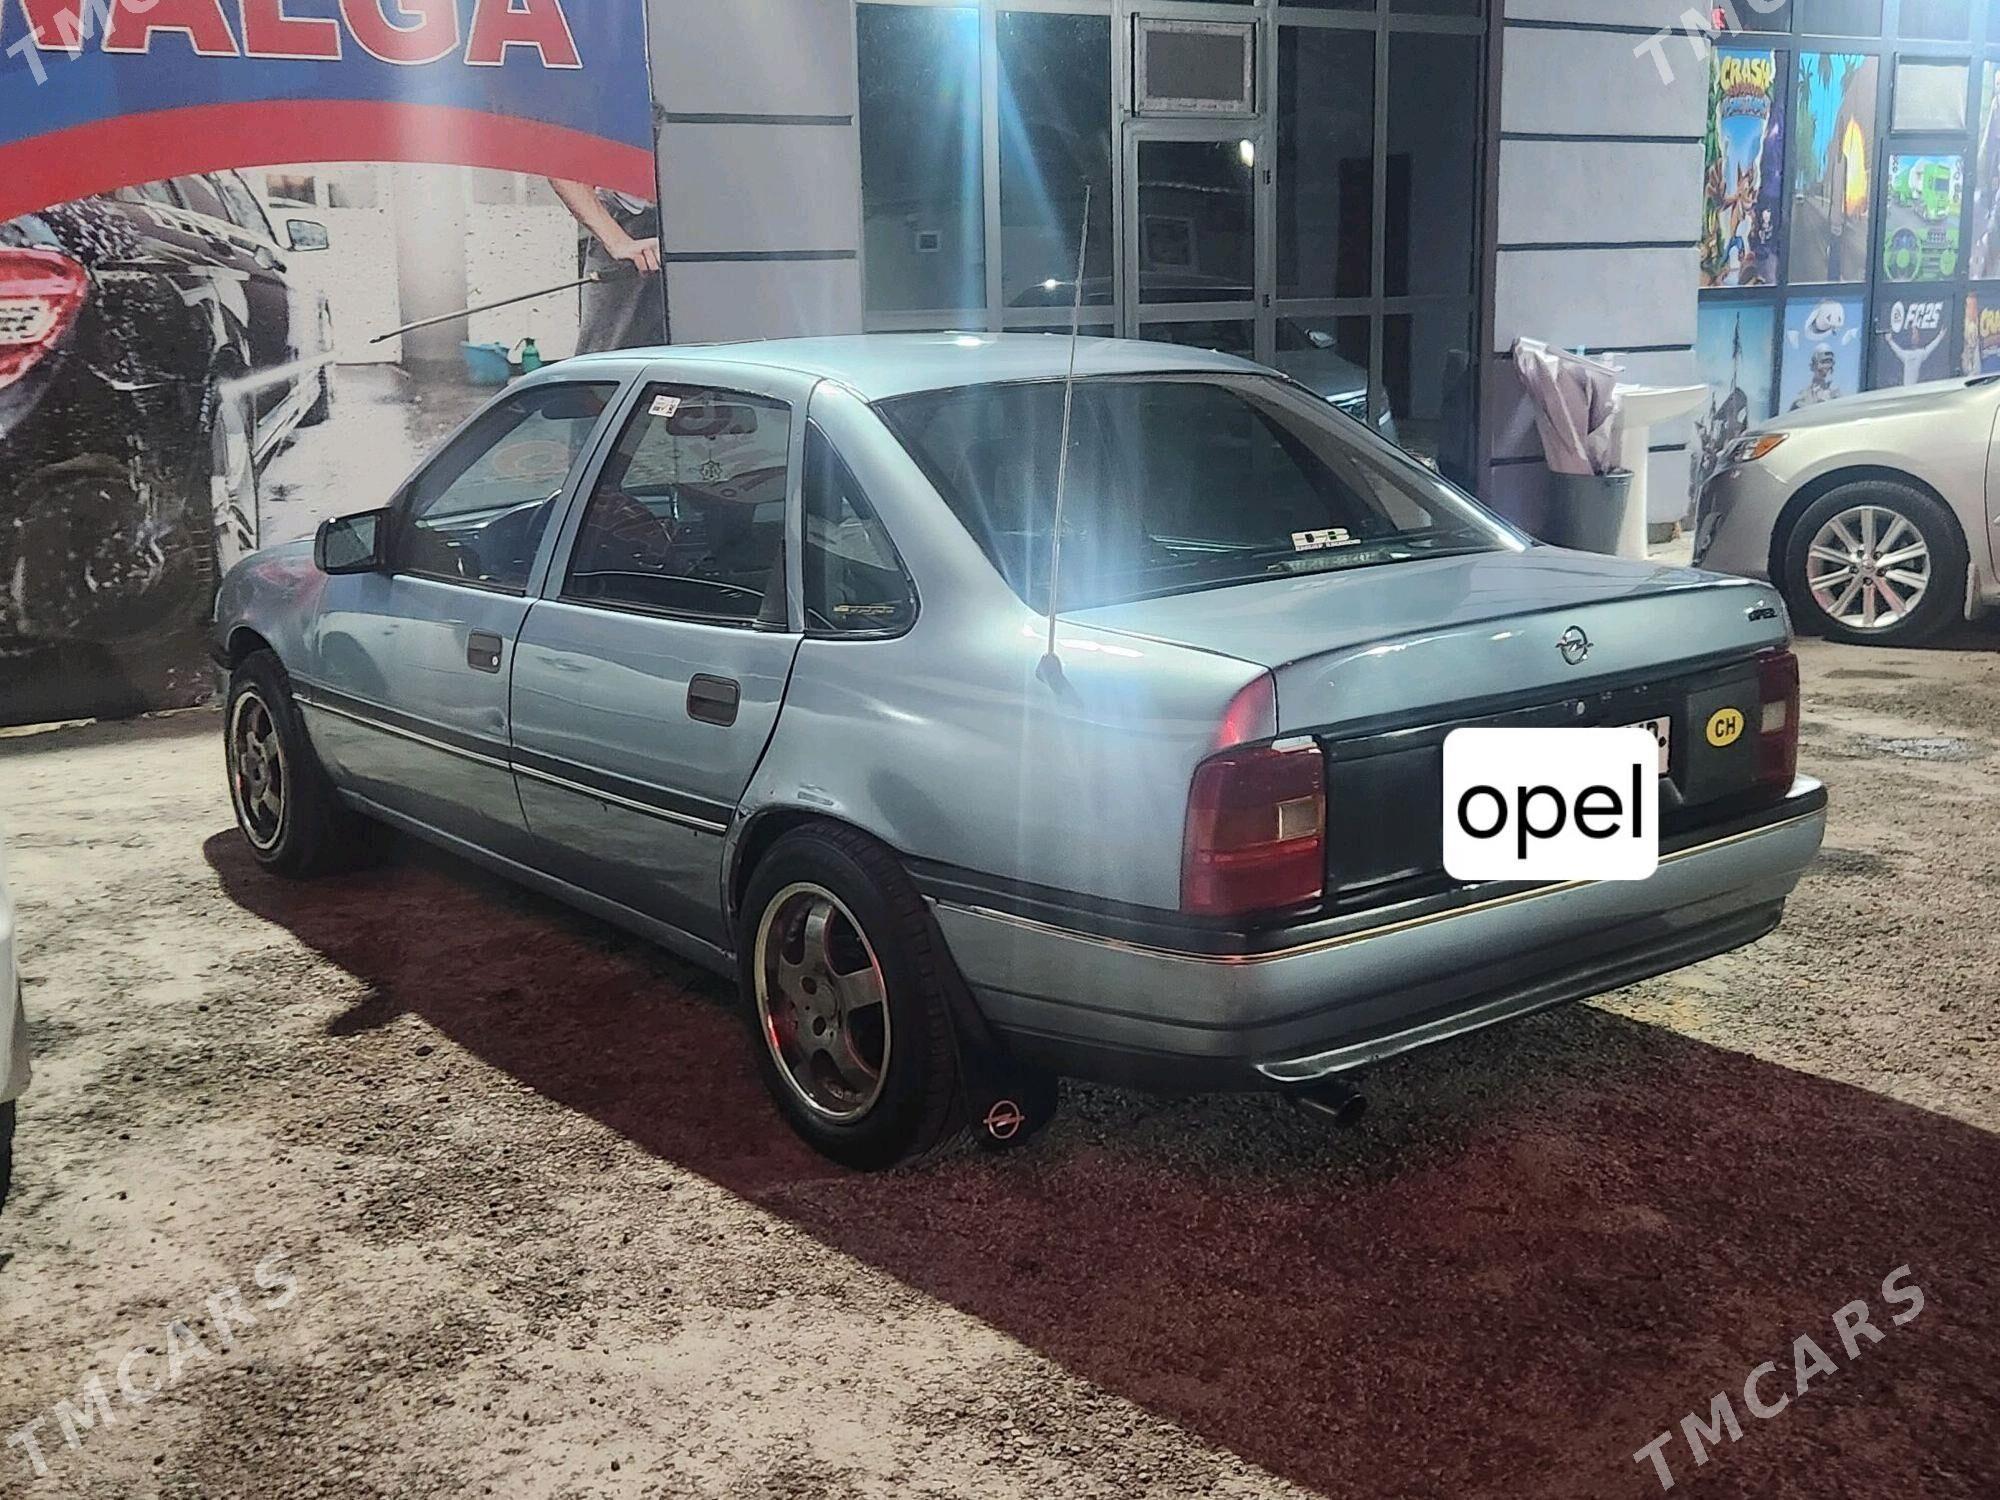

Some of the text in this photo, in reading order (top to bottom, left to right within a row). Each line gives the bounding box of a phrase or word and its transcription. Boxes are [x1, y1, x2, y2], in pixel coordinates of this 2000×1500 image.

[1720, 55, 1773, 92] CRASH
[1904, 301, 1944, 330] FC25
[1715, 716, 1736, 738] CH
